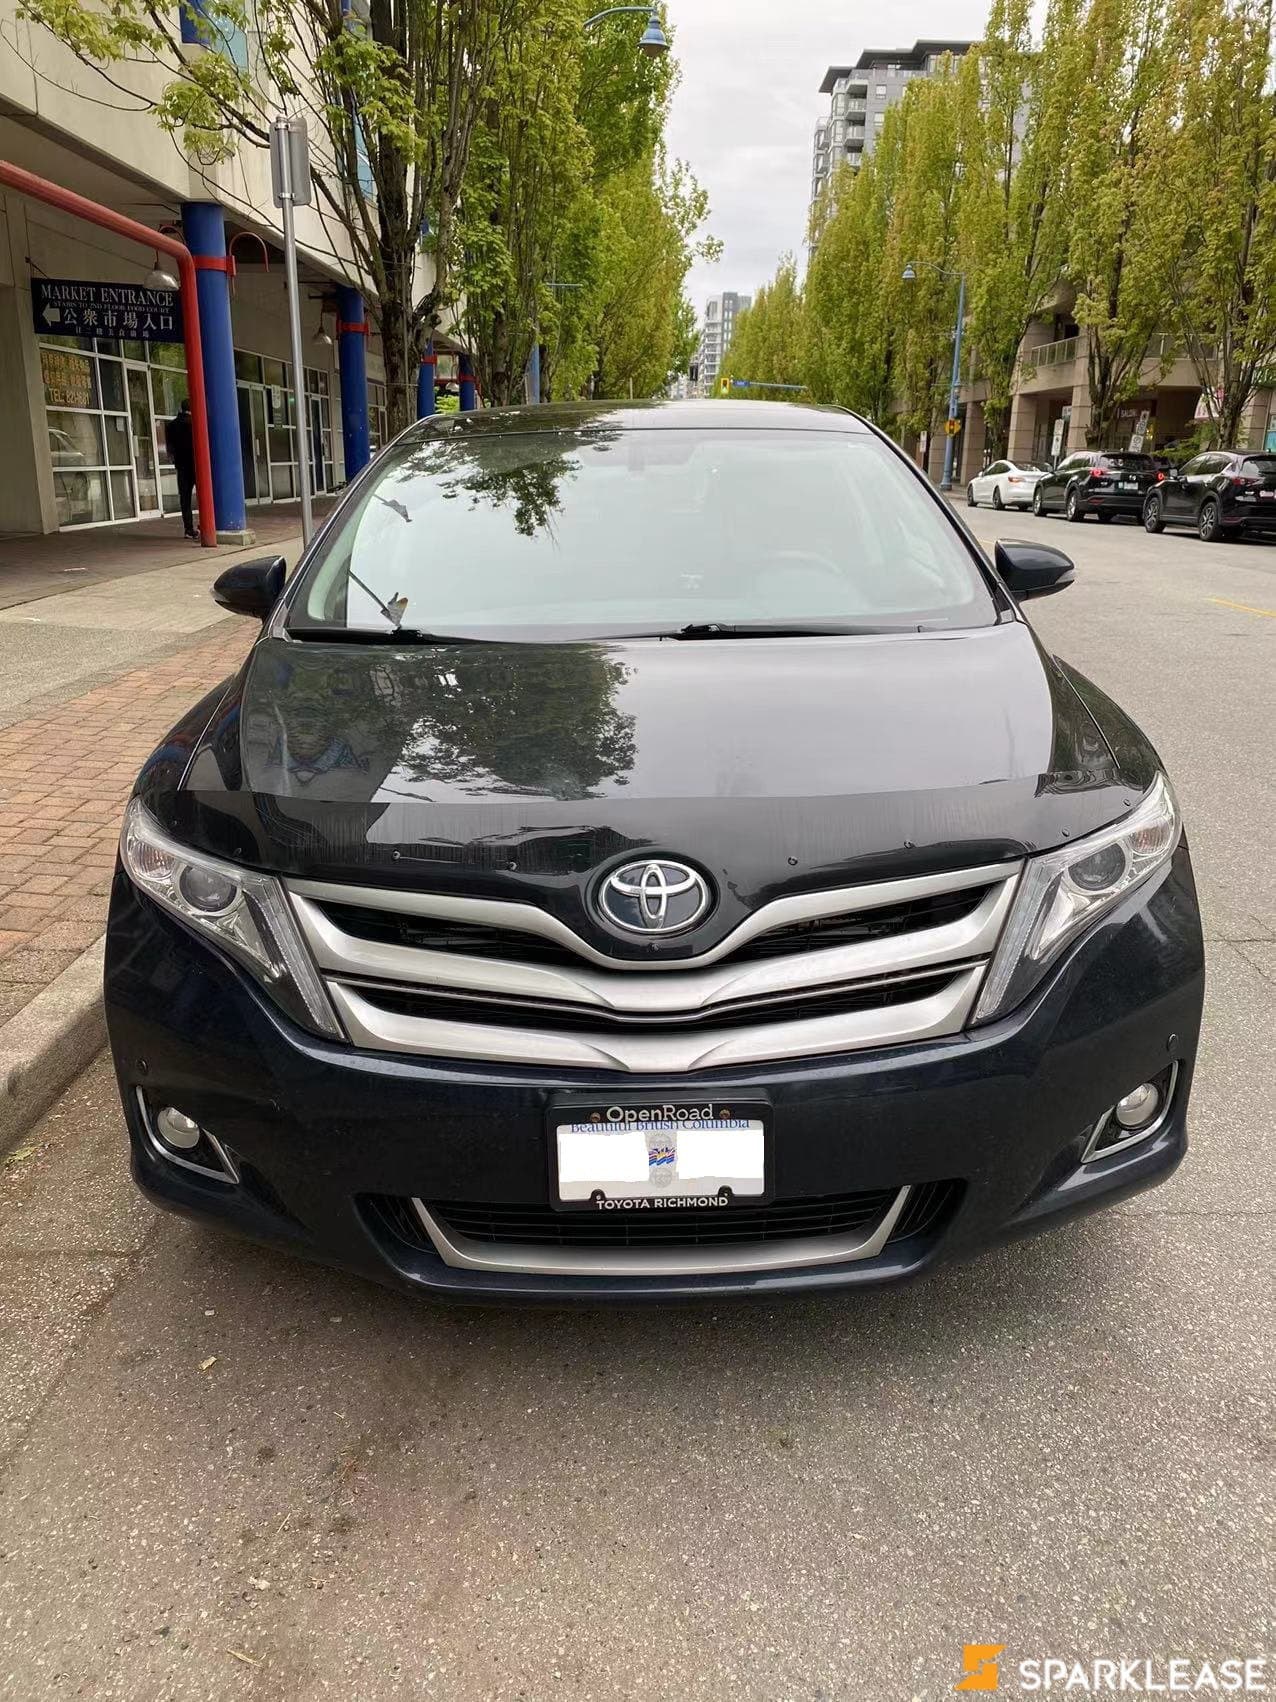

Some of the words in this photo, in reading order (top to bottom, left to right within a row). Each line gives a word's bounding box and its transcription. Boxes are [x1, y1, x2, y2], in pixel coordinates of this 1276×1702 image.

[41, 284, 96, 301] MARKET
[101, 287, 174, 307] ENTRANCE
[103, 303, 126, 311] FLOOR
[606, 1104, 714, 1123] OpenRoad
[596, 1199, 650, 1210] TOYOTA
[653, 1197, 729, 1208] RICHMOND
